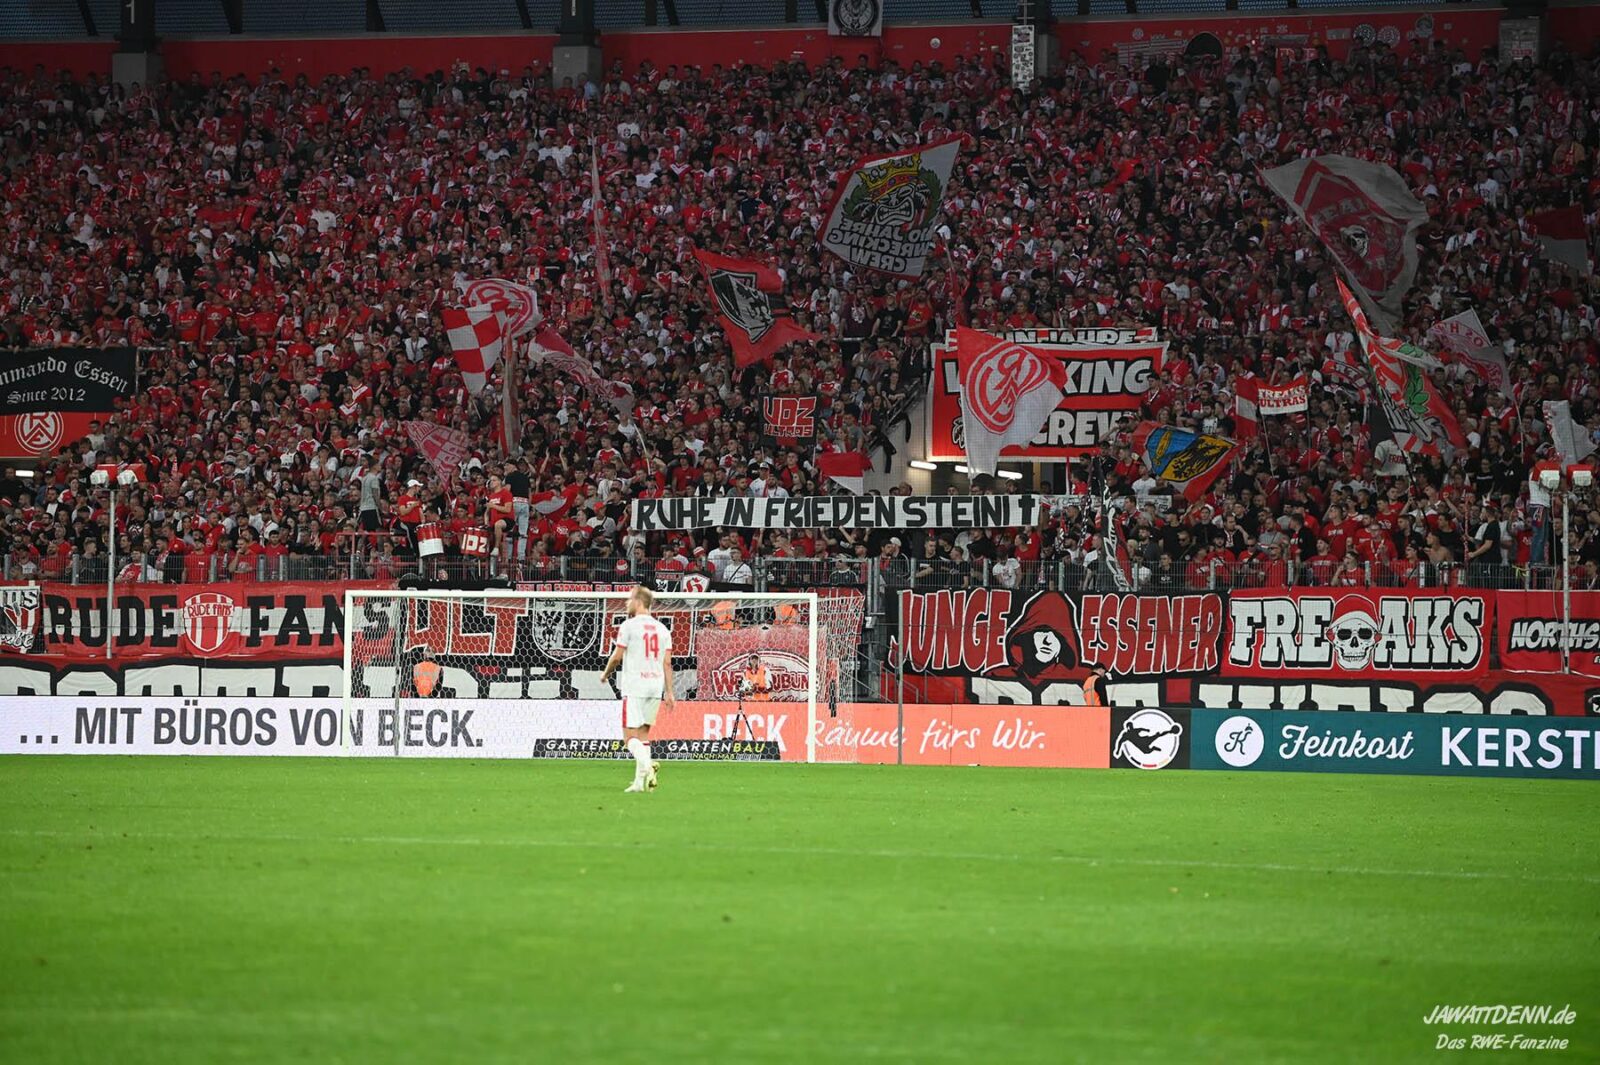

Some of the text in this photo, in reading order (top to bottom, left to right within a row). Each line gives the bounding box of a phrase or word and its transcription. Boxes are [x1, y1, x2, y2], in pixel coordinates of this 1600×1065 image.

[74, 359, 129, 393] Essen
[1258, 384, 1306, 400] FREAKS
[7, 387, 87, 404] Since 2012
[763, 396, 817, 426] UDZ
[1259, 396, 1306, 408] ULTRAS
[637, 496, 1010, 529] RUHE IN FRIEDEN STEINI
[46, 594, 391, 648] RUDE FANS
[889, 588, 1222, 675] JUNGE ESSENER
[1229, 597, 1484, 672] FREAKS
[1510, 620, 1600, 650] NORTHS
[643, 632, 660, 661] 14
[75, 707, 142, 745] MIT
[154, 700, 277, 746] BÜROS
[290, 708, 363, 747] VON
[377, 708, 484, 748] BECK.
[703, 713, 788, 752] BECK
[805, 717, 1046, 754] Räume fürs Wir.
[546, 739, 629, 751] GARTENB
[667, 741, 766, 753] GARTENBAU
[1279, 723, 1415, 761] Feinkost
